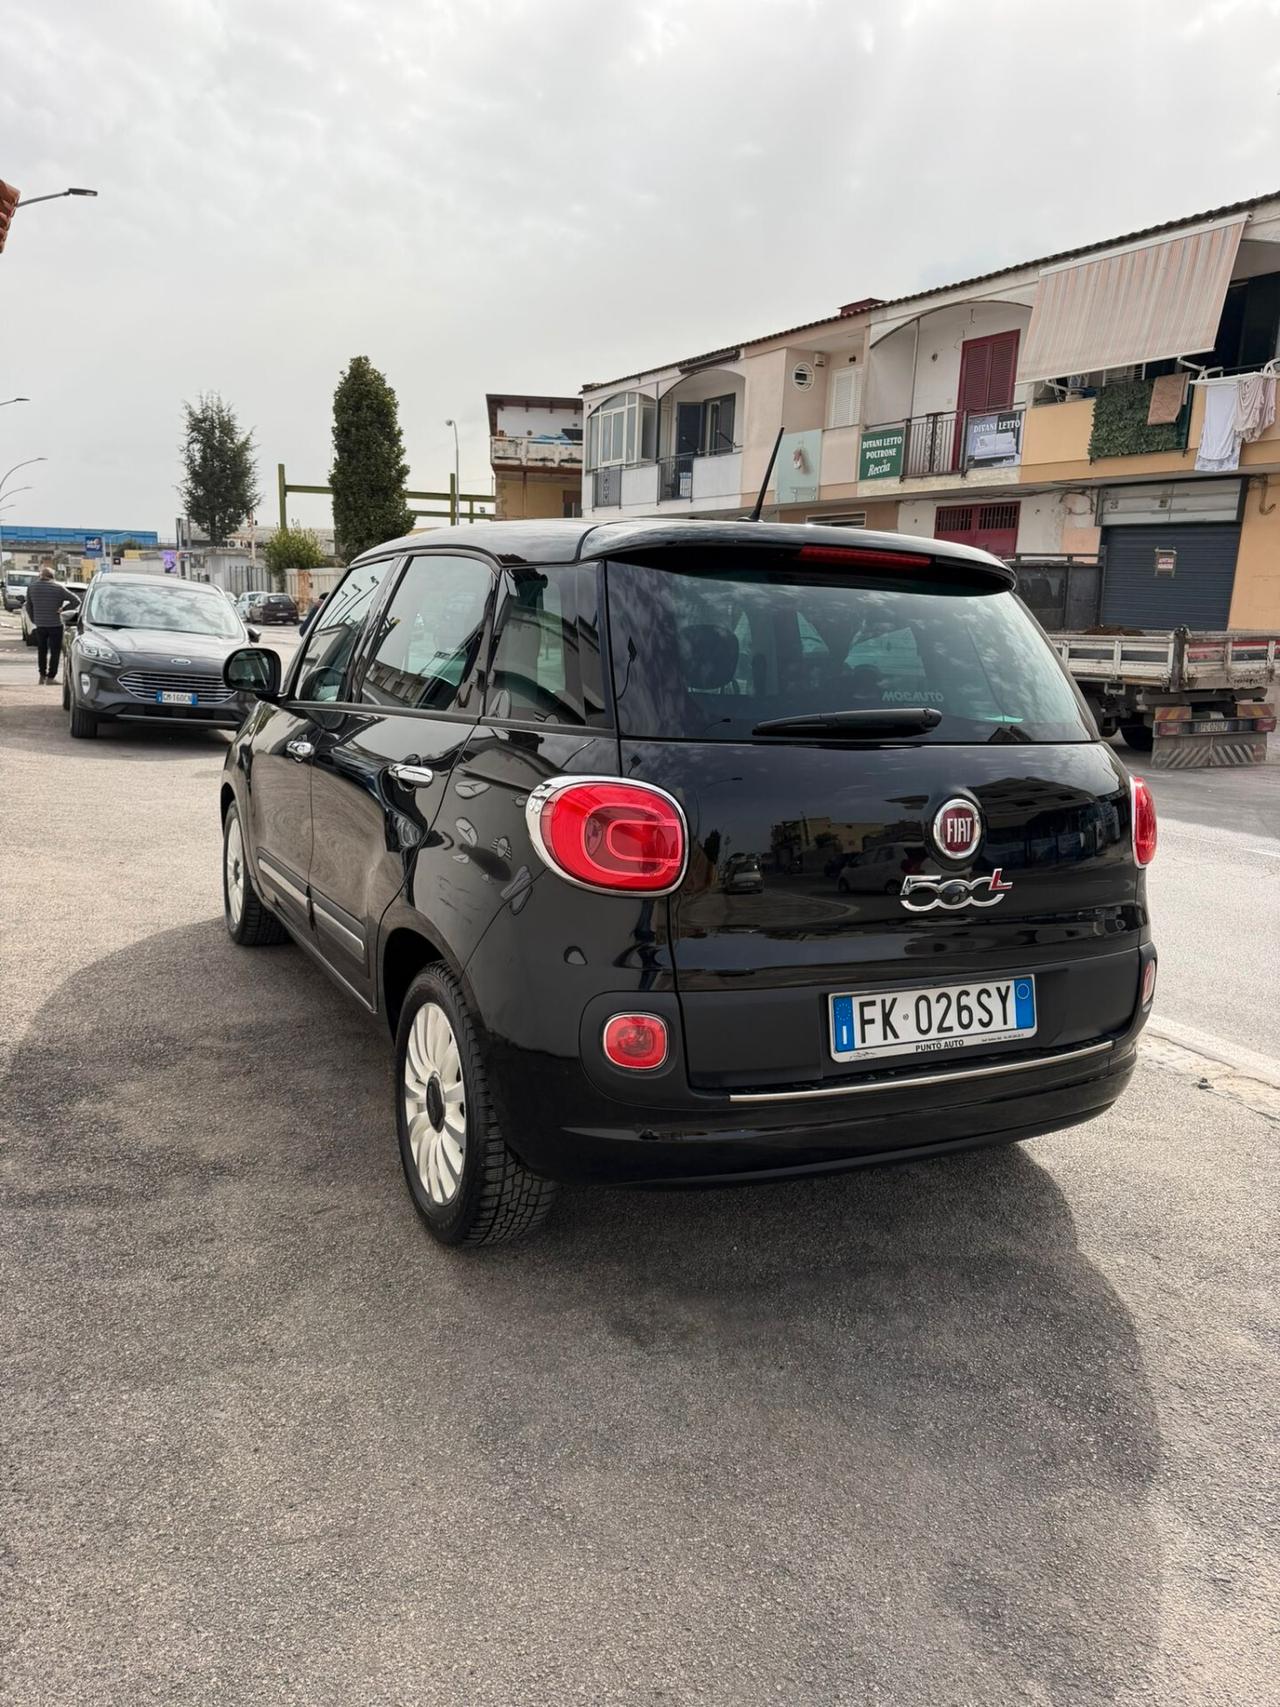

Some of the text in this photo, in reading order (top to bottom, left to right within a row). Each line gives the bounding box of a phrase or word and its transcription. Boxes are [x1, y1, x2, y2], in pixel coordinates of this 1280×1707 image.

[999, 420, 1020, 430] LETTO
[883, 436, 902, 446] LETTO
[866, 448, 897, 459] POLTRONE
[947, 818, 972, 843] FIAT
[858, 997, 900, 1044] FK
[914, 985, 1011, 1036] 026SY
[915, 1039, 965, 1053] PUNTO AUTO
